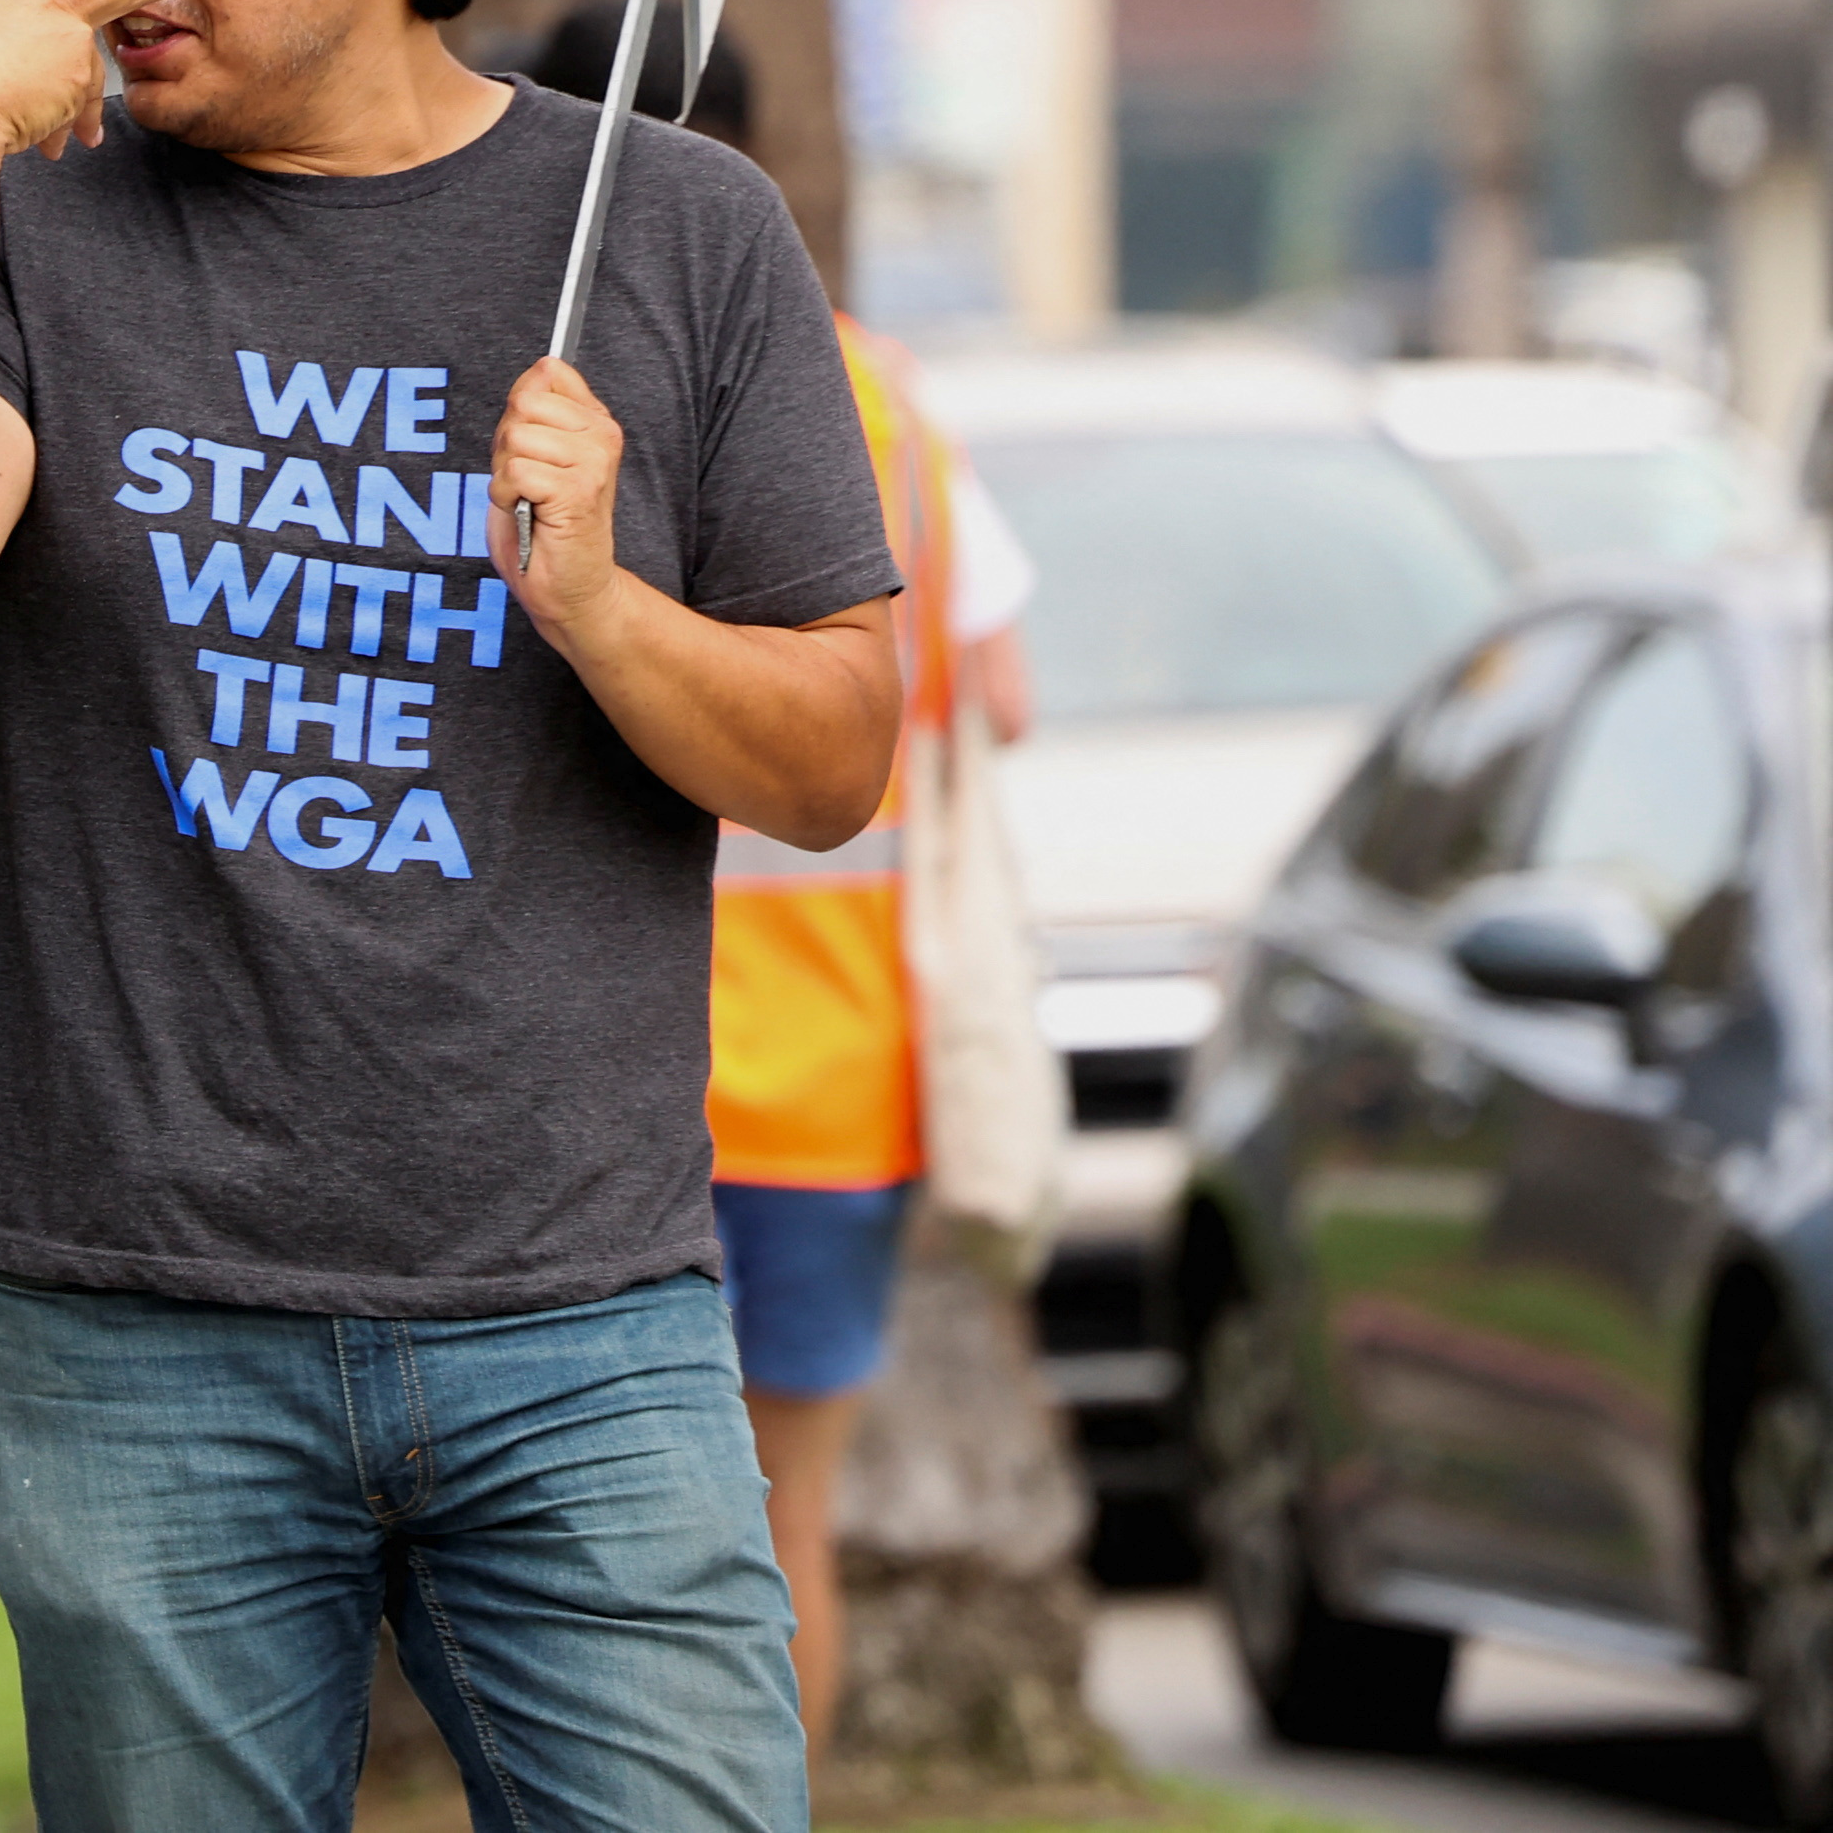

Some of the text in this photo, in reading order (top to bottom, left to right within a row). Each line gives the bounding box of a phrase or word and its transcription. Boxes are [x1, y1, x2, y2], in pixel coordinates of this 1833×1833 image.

[236, 349, 448, 453] WE
[149, 531, 507, 668] WITH
[197, 648, 435, 769] THE
[150, 746, 472, 879] WGA
